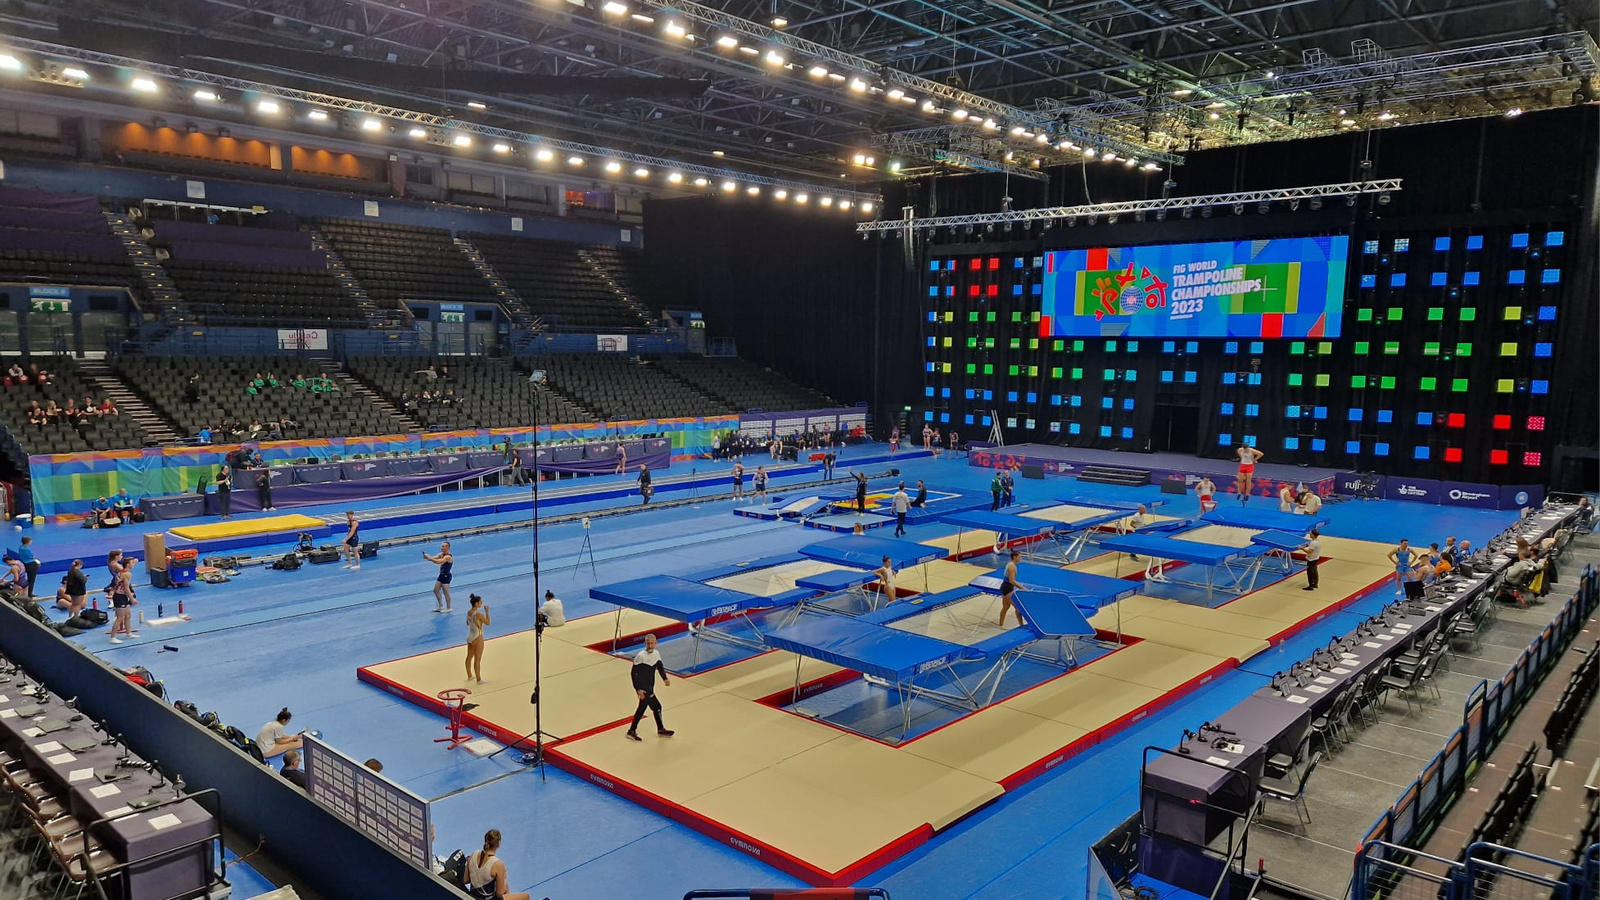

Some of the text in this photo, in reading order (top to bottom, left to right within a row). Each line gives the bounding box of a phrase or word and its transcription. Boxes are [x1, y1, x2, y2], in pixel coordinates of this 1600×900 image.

[1173, 260, 1217, 274] FIG WORLD
[1173, 268, 1243, 287] TRAMPOLINE
[1172, 279, 1261, 300] CHAMPIONSHIPS
[1171, 299, 1203, 314] 2023
